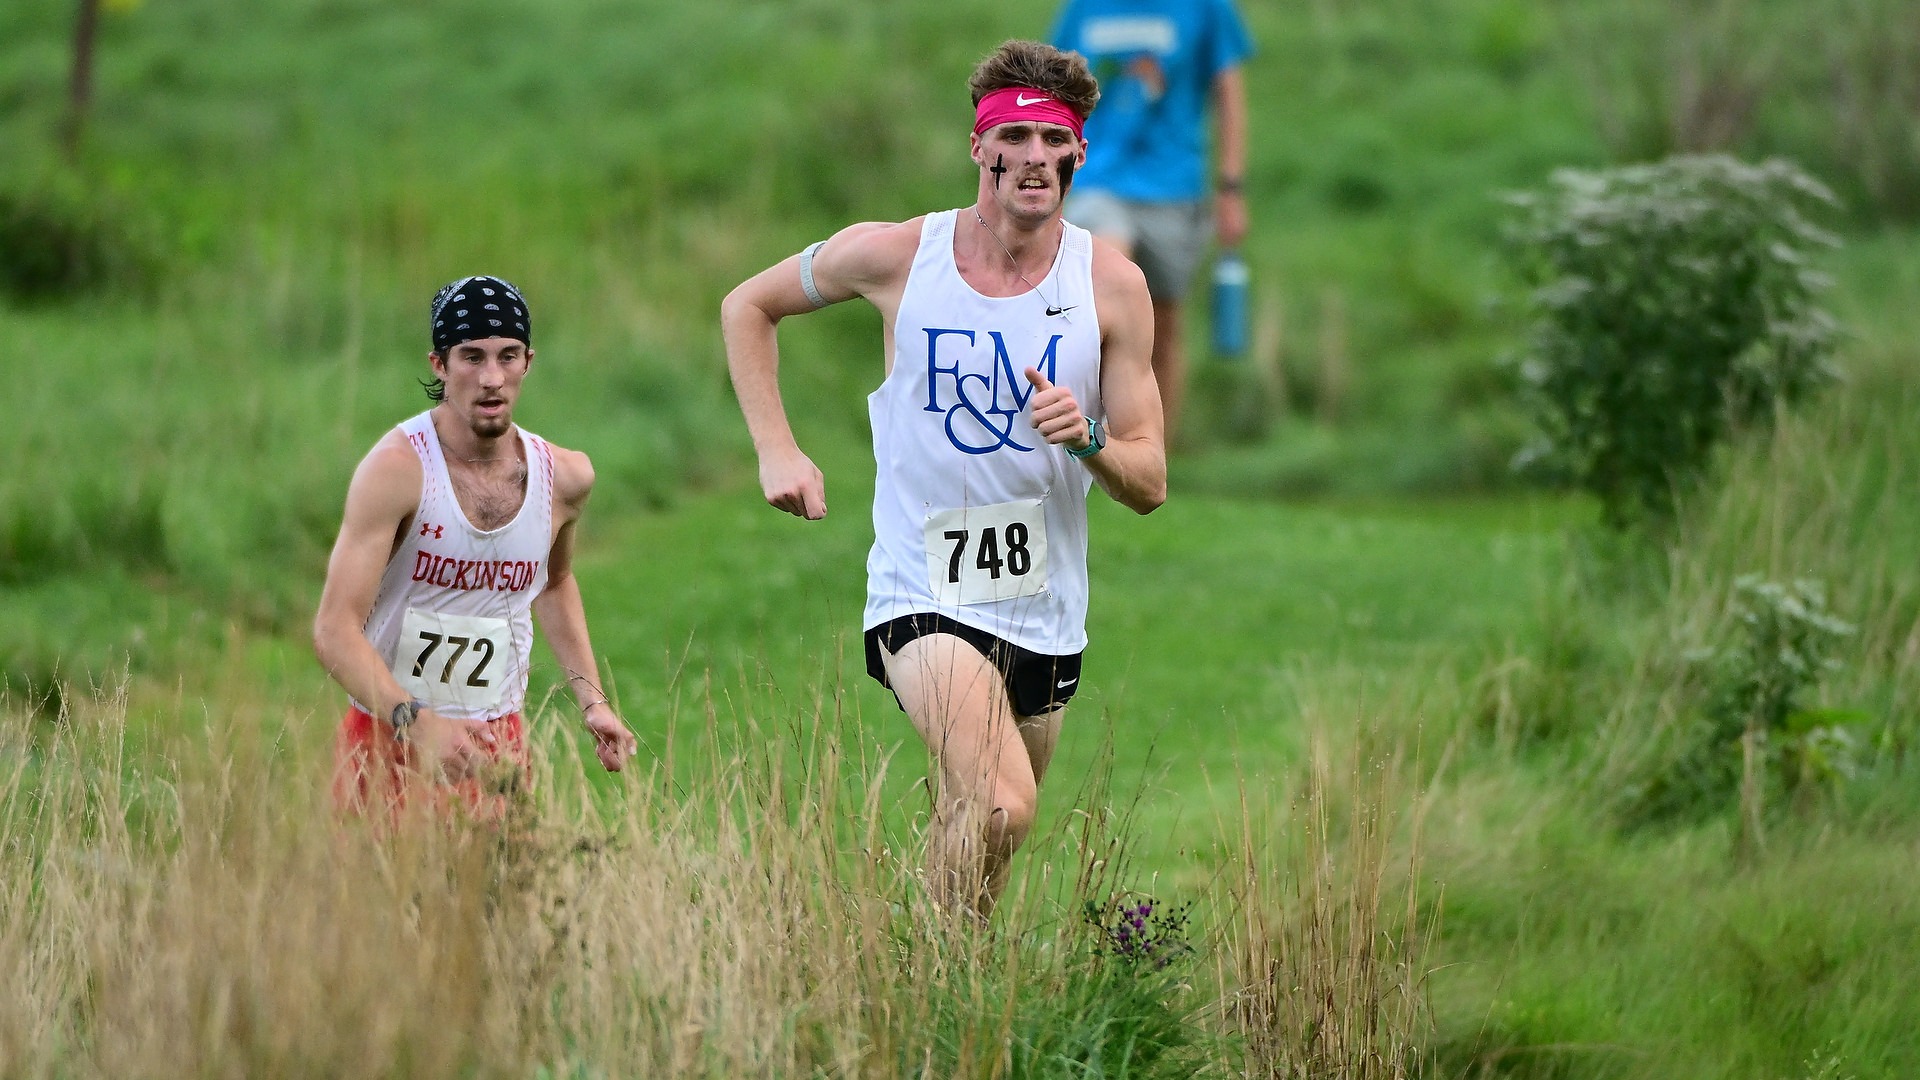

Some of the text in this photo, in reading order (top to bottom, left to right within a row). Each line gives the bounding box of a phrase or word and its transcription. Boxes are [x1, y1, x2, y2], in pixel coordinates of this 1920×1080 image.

[922, 328, 1063, 454] F&M
[412, 550, 539, 592] DICKINSON
[943, 522, 1032, 584] 748
[411, 631, 495, 688] 772
